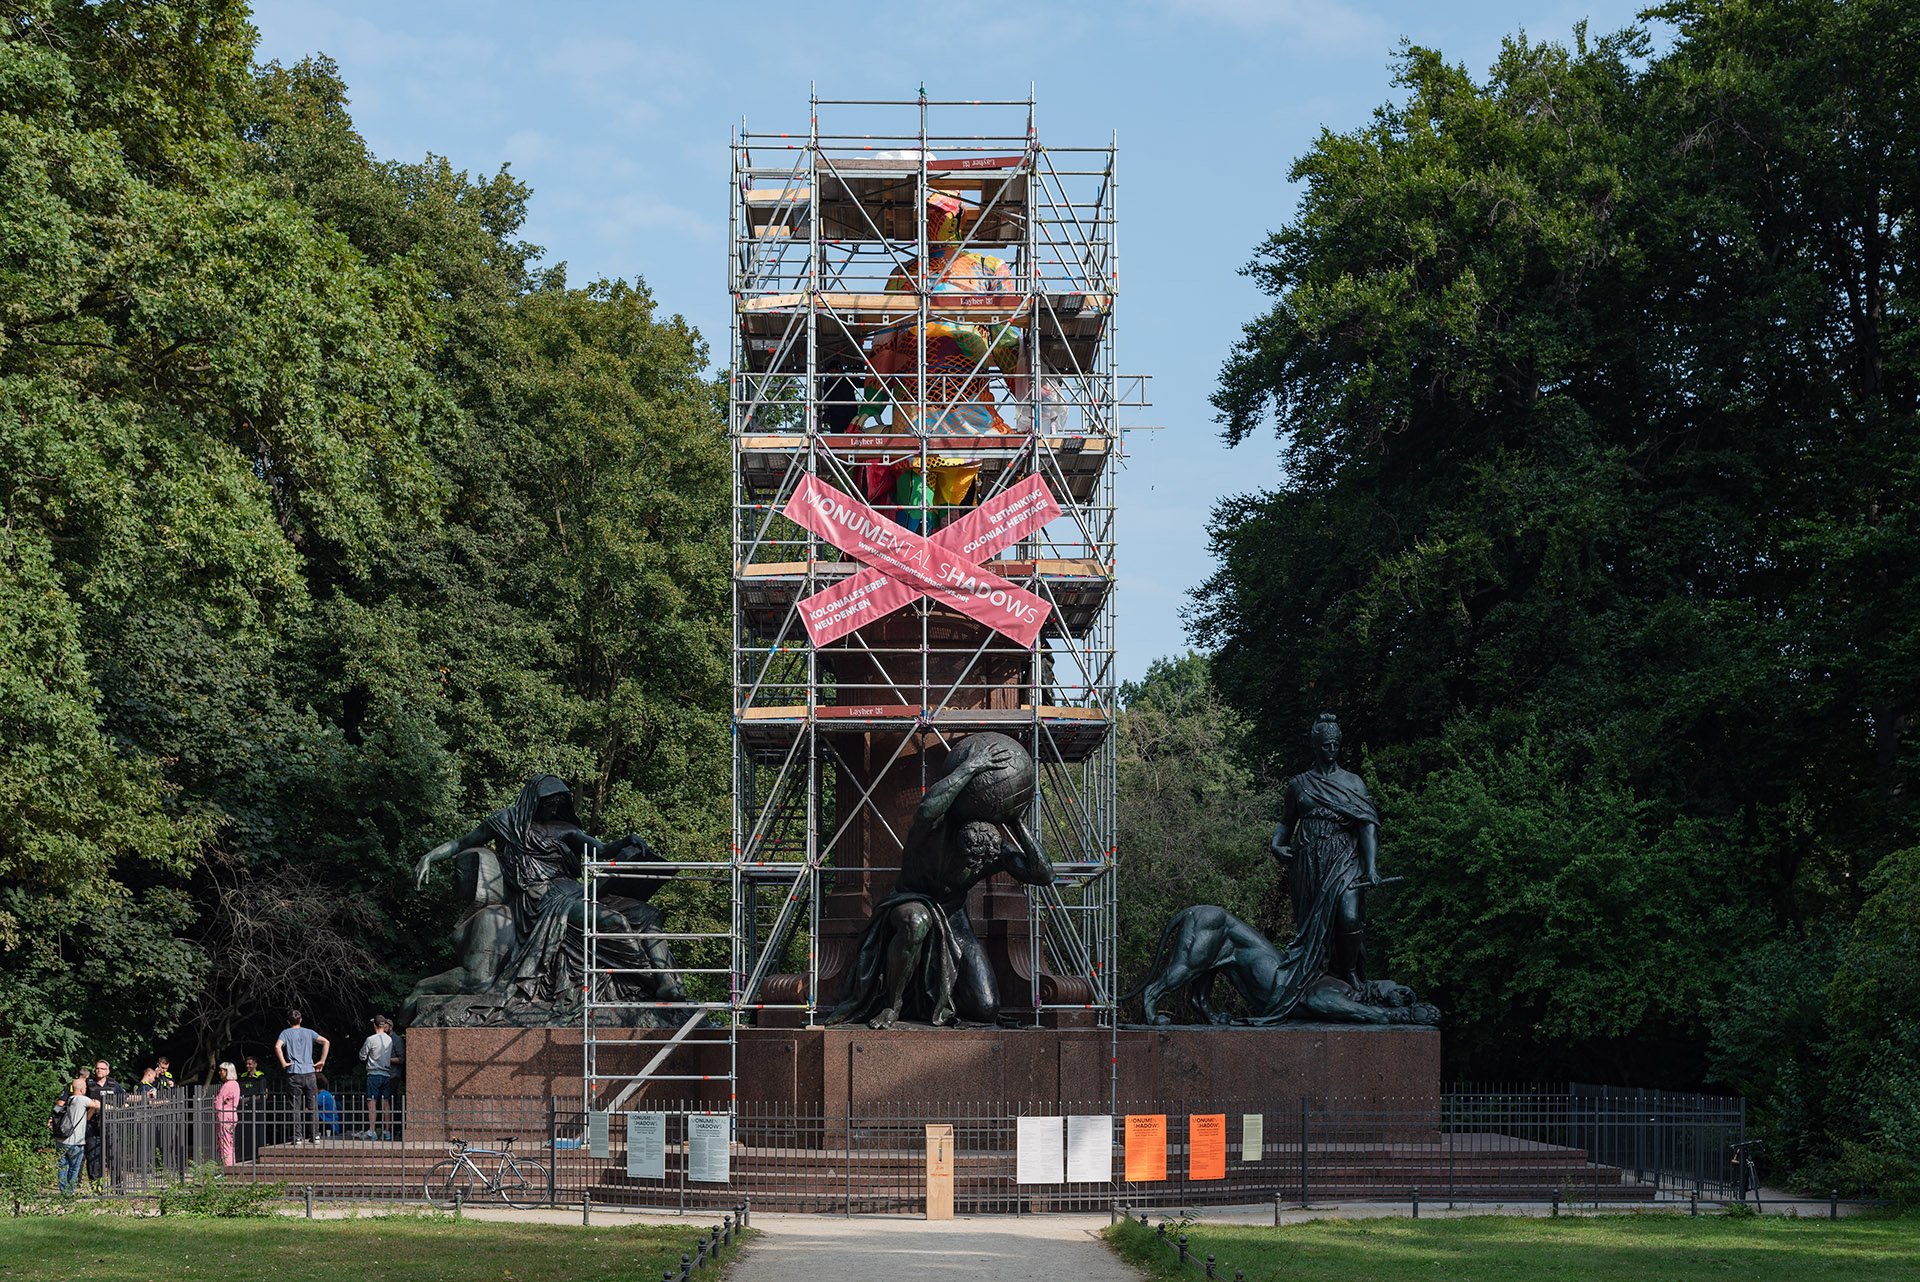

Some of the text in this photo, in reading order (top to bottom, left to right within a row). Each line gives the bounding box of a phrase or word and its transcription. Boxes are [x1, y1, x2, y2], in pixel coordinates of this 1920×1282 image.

[972, 158, 996, 167] Layher
[960, 297, 984, 306] Layher
[850, 438, 875, 446] Layher
[989, 489, 1044, 525] RETHINKING
[963, 499, 1049, 555] COLONIAL HERITAGE
[801, 488, 1039, 625] MONUMENTAL SHADOWS
[809, 577, 889, 621] KOLONIALES ERBE
[814, 599, 871, 632] NEU DENKEN
[849, 708, 873, 717] Layher
